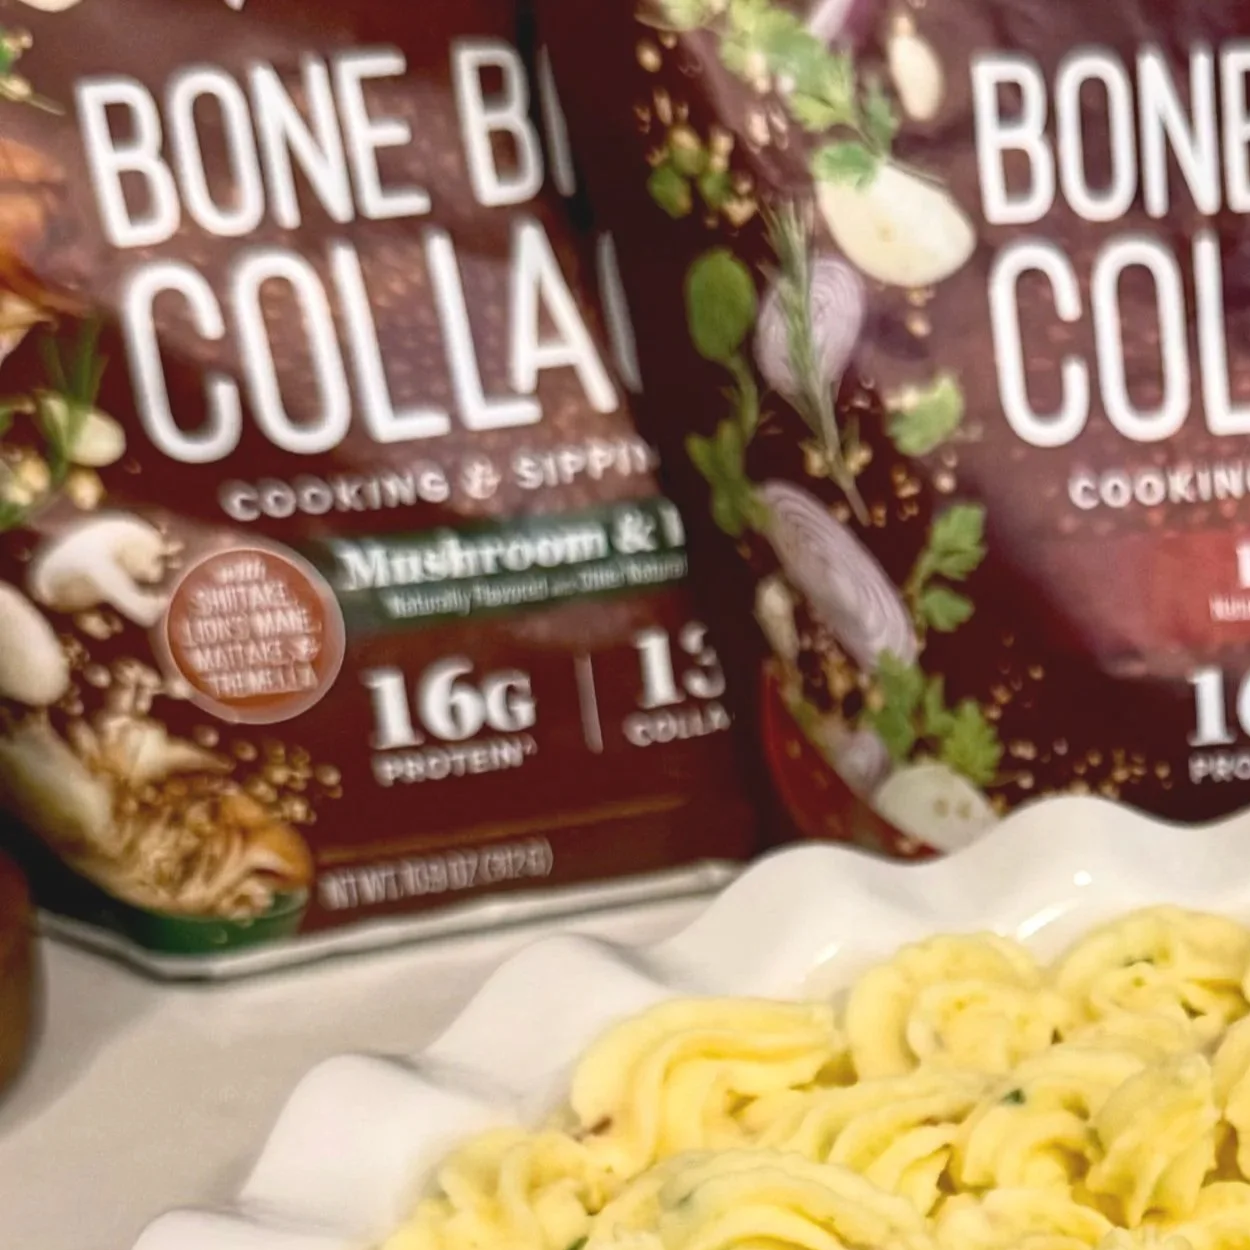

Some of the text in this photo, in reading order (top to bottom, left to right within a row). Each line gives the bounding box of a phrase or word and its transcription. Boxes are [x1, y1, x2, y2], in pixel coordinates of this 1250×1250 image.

[76, 45, 432, 249] BONE
[218, 460, 449, 522] COOKING
[459, 455, 500, 500] &
[336, 523, 608, 592] Mushroom
[611, 504, 657, 556] &
[360, 654, 538, 750] 16G
